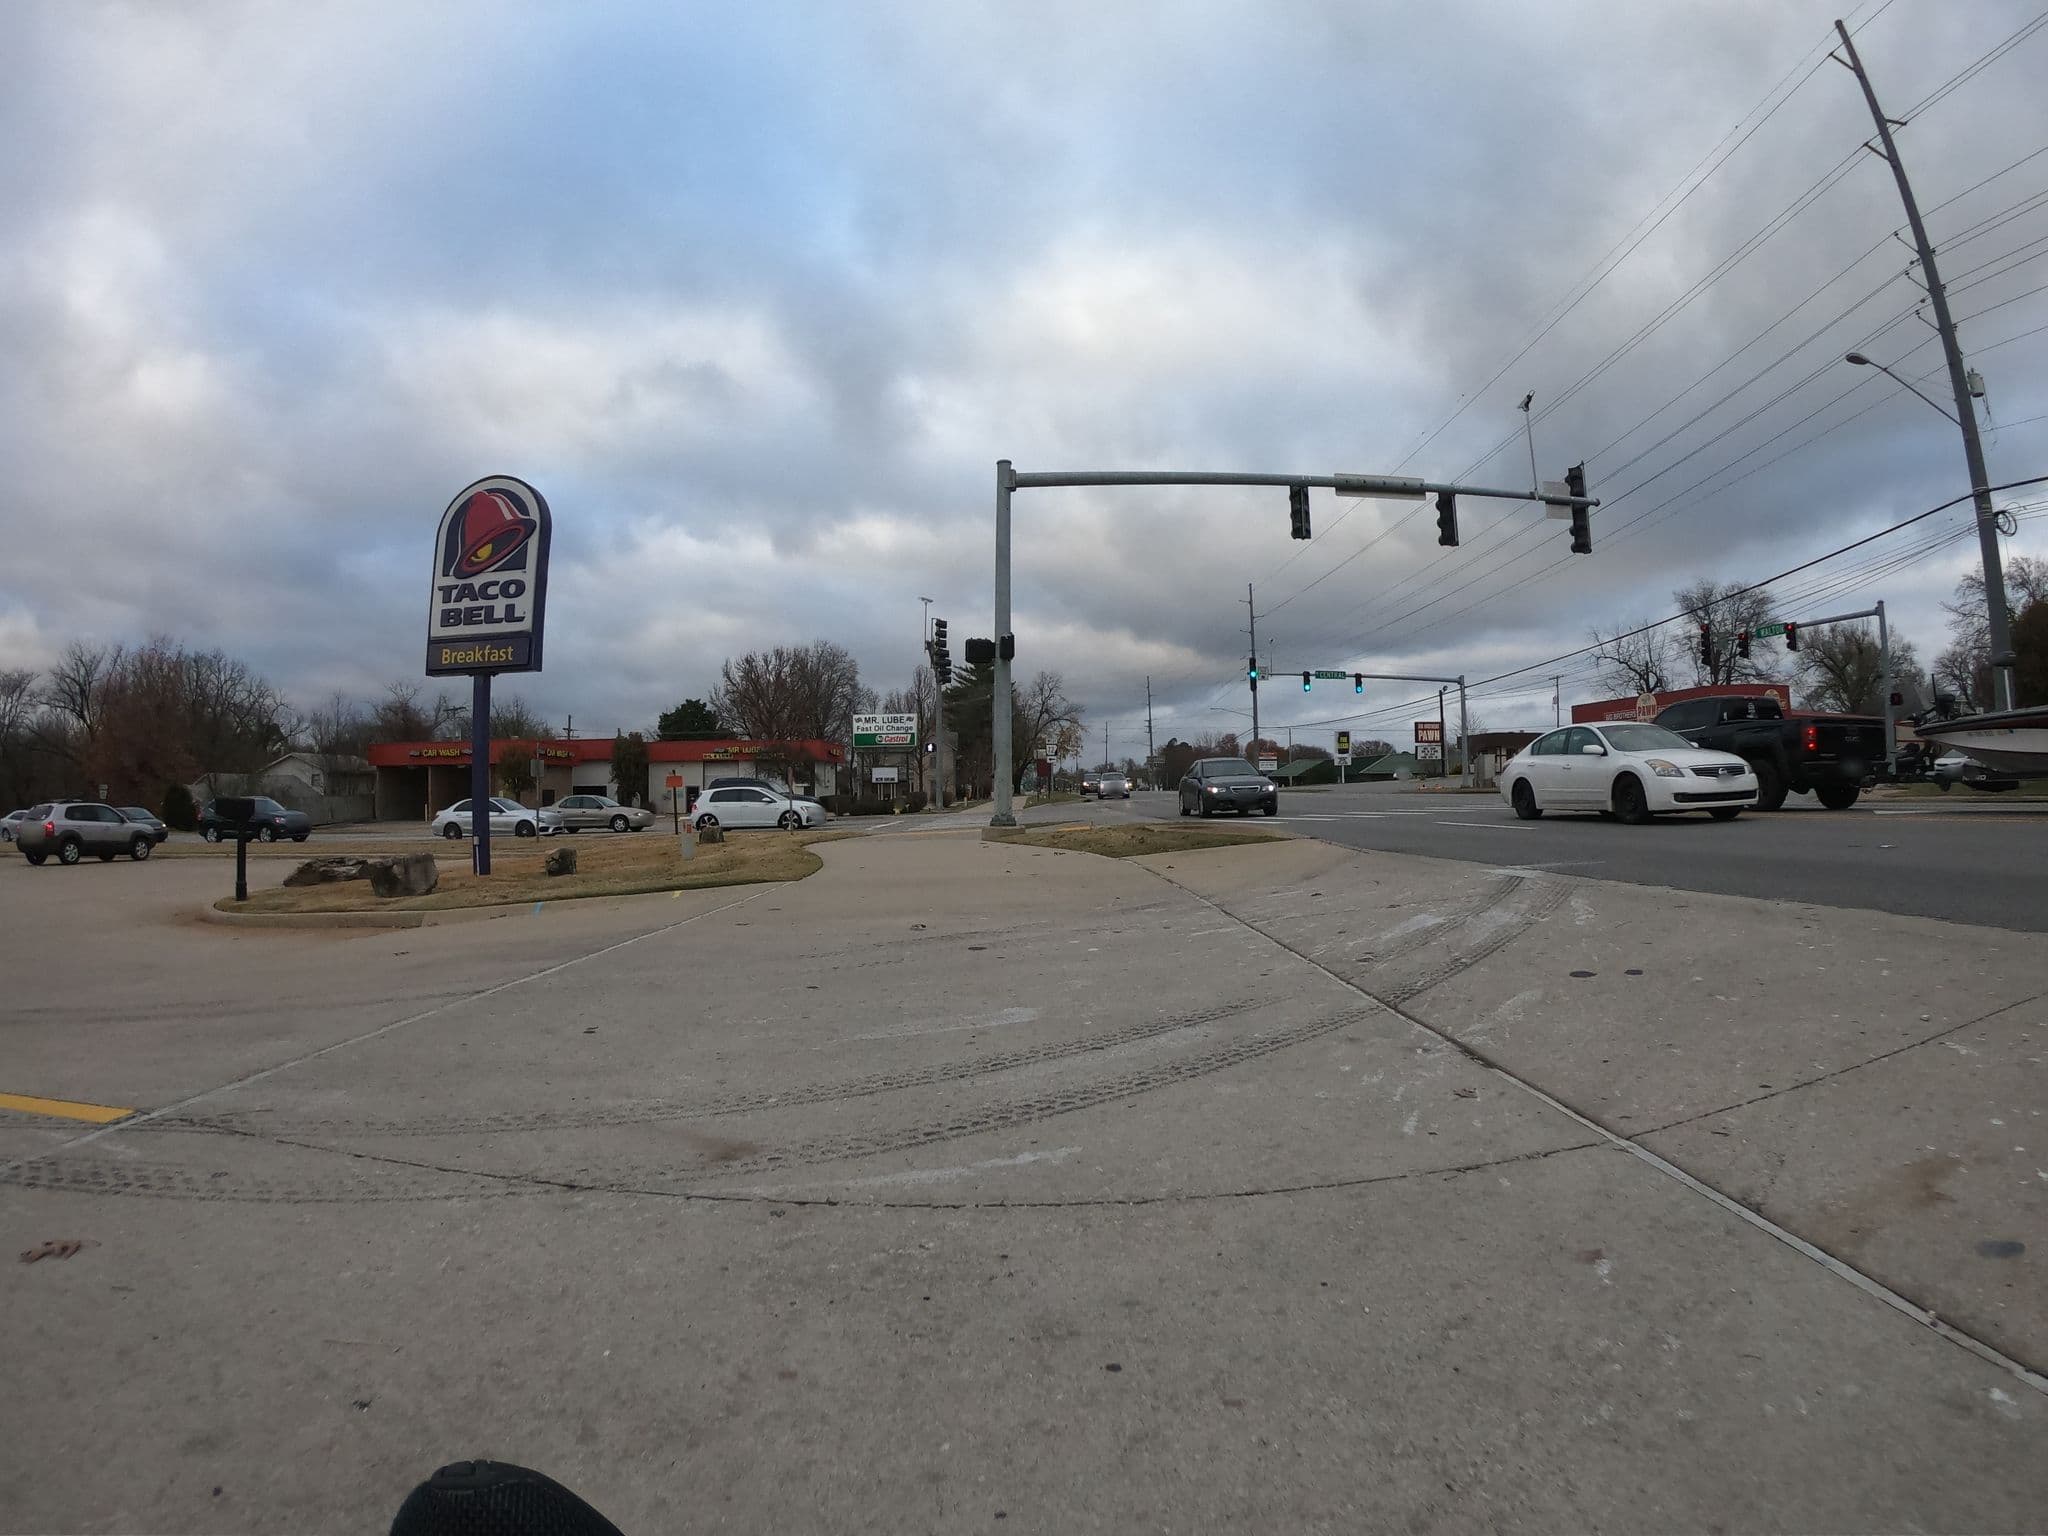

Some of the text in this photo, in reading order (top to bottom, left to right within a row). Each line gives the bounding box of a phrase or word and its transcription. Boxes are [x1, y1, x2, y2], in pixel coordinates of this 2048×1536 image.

[437, 579, 526, 604] TACO
[440, 604, 525, 627] BELL
[441, 645, 514, 665] Breakfast
[1319, 671, 1345, 679] CENTRAL
[863, 715, 905, 724] MR. LUBE
[885, 724, 914, 733] Change
[884, 735, 909, 743] Castrol
[1418, 730, 1440, 741] PAWN
[422, 748, 460, 757] CAR WASH
